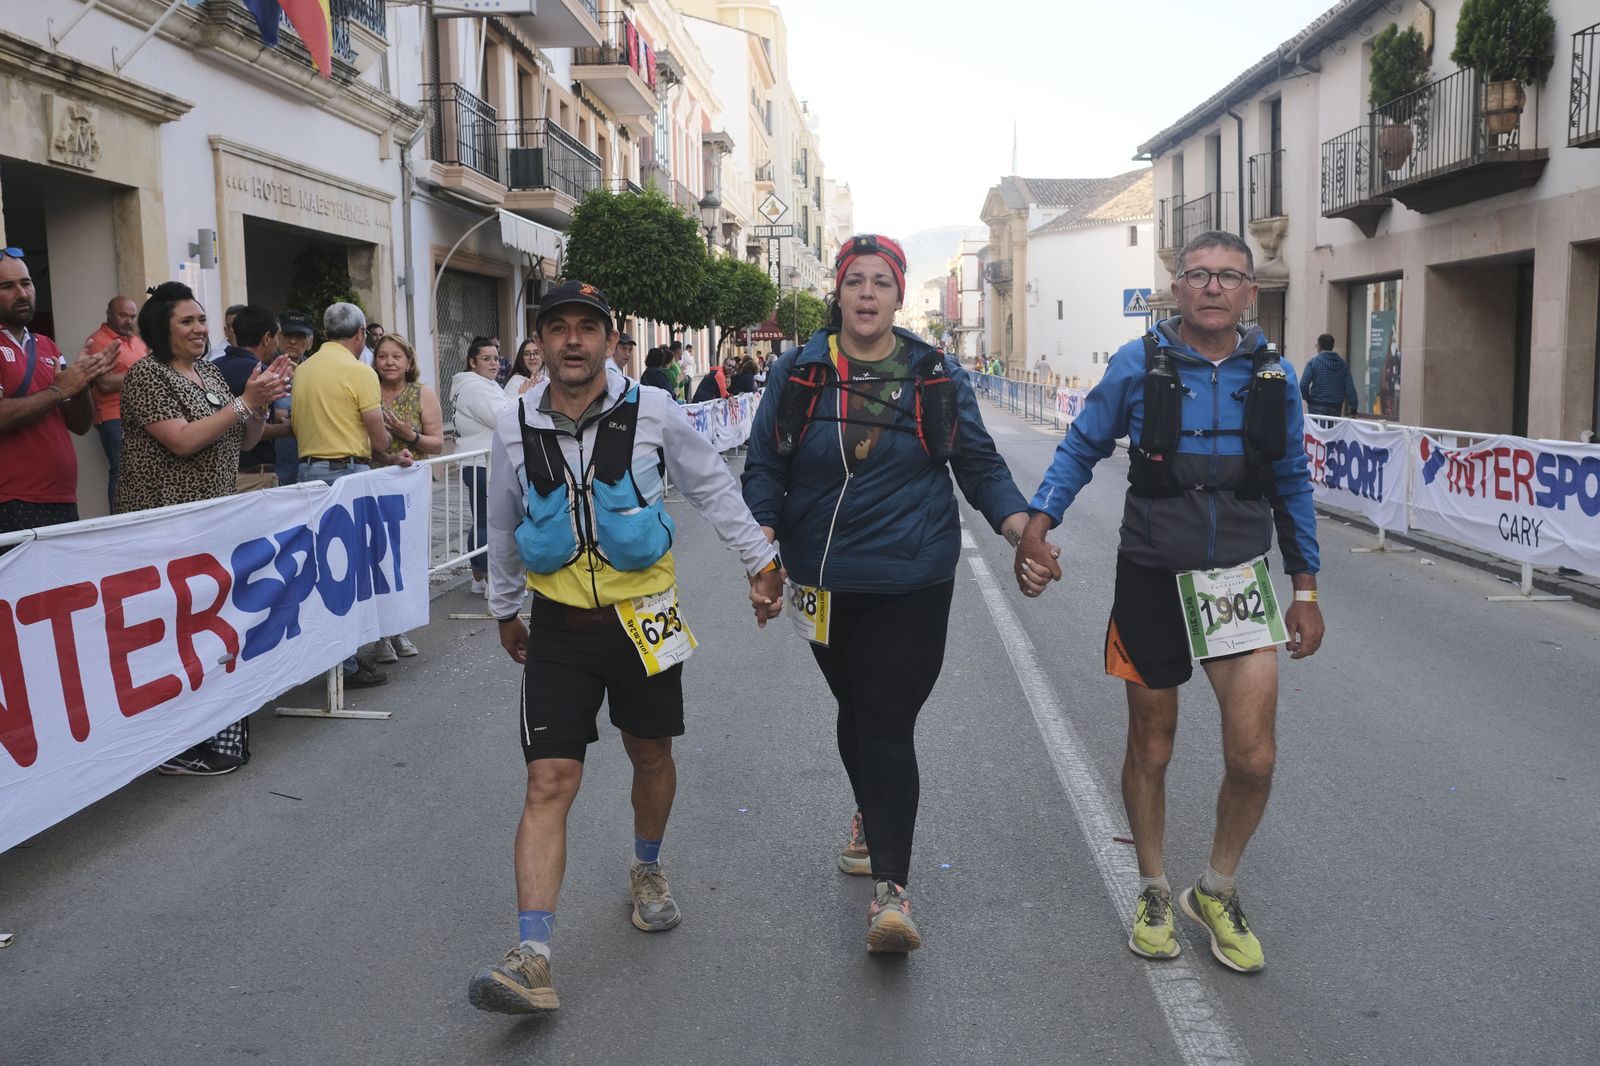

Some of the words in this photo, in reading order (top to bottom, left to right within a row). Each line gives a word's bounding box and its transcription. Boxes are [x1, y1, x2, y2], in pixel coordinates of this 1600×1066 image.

[252, 176, 297, 208] HOTEL
[299, 190, 370, 227] MAESTRANZA
[1498, 512, 1543, 548] CARY
[641, 606, 682, 645] 623
[1200, 589, 1266, 627] 1902
